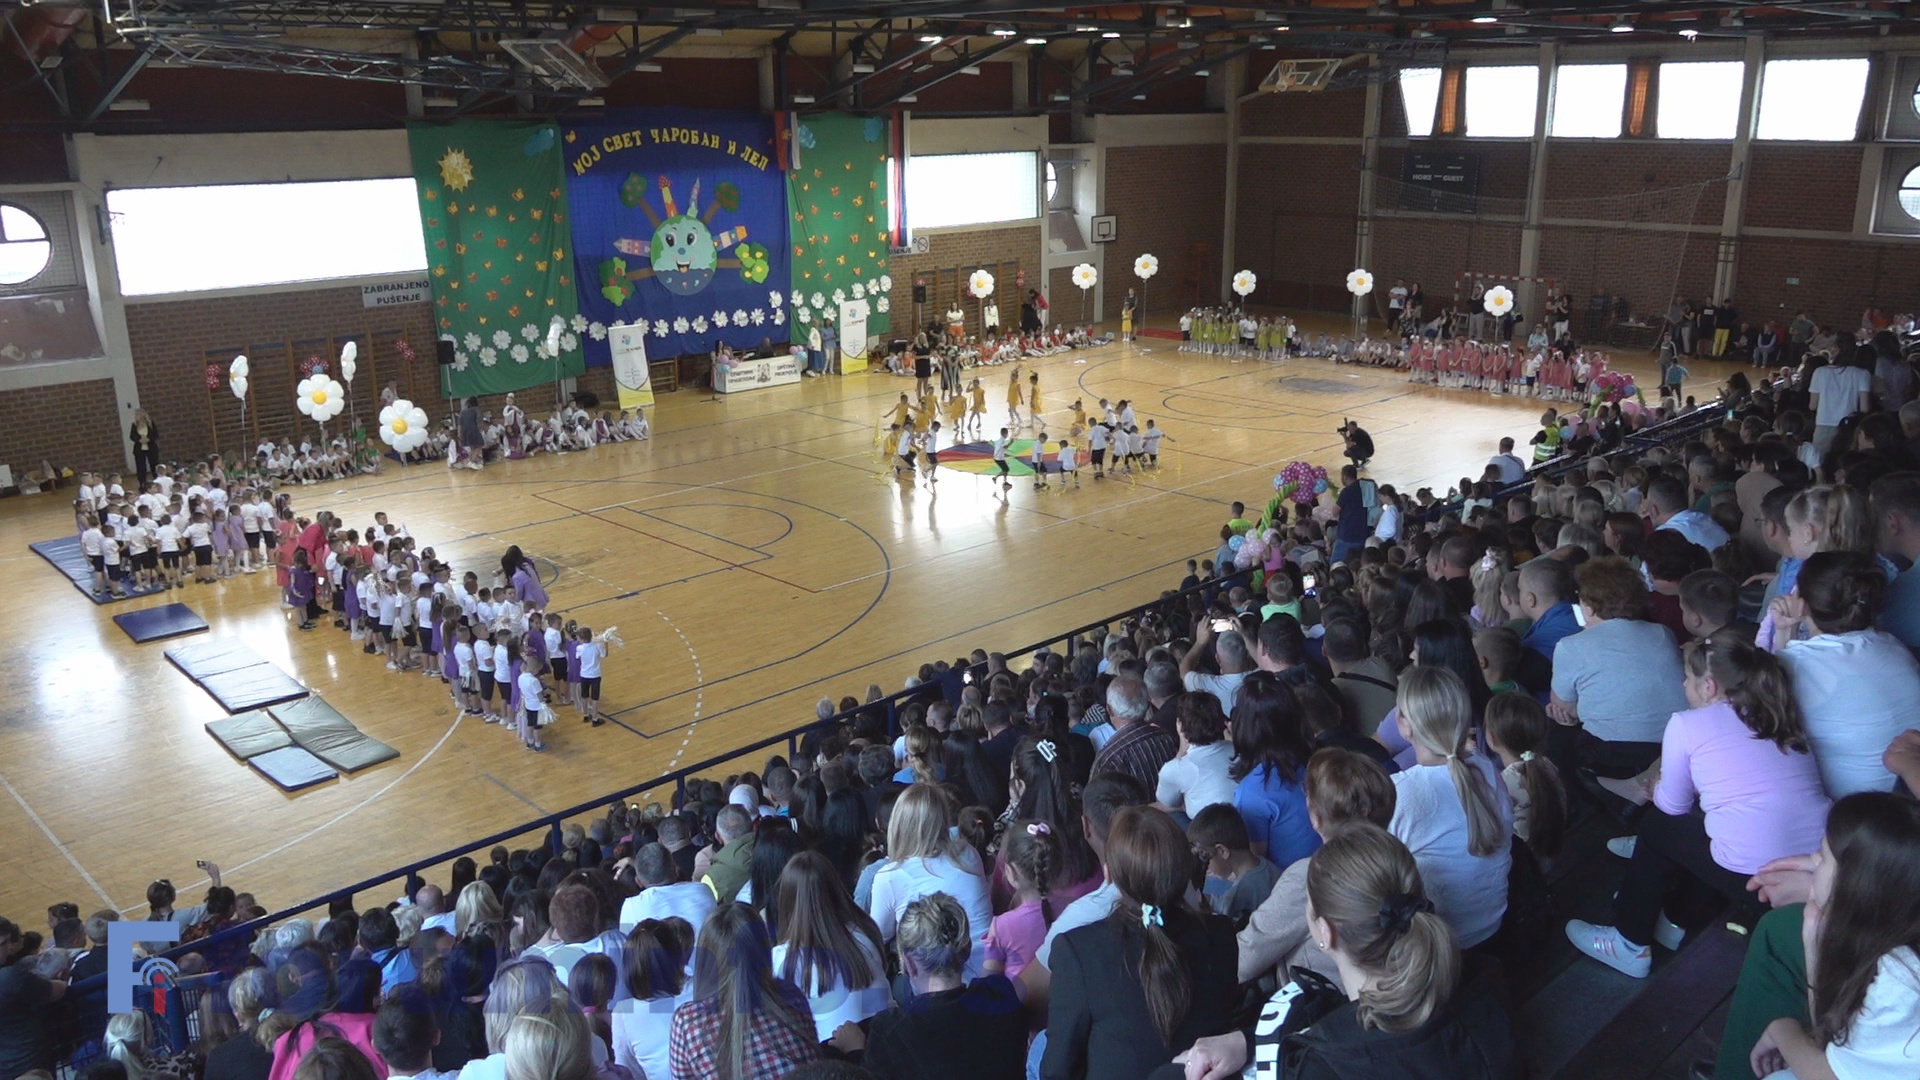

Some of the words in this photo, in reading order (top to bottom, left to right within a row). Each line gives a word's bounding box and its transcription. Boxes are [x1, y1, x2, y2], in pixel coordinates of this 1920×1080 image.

[572, 144, 601, 176] МОЈ
[602, 130, 643, 153] СВЕТ
[650, 127, 721, 149] ЧАРОБАН
[727, 140, 736, 155] И
[740, 145, 769, 172] ЛЕП
[363, 280, 429, 294] ZABRANJENO
[376, 293, 421, 304] PUŠENJE
